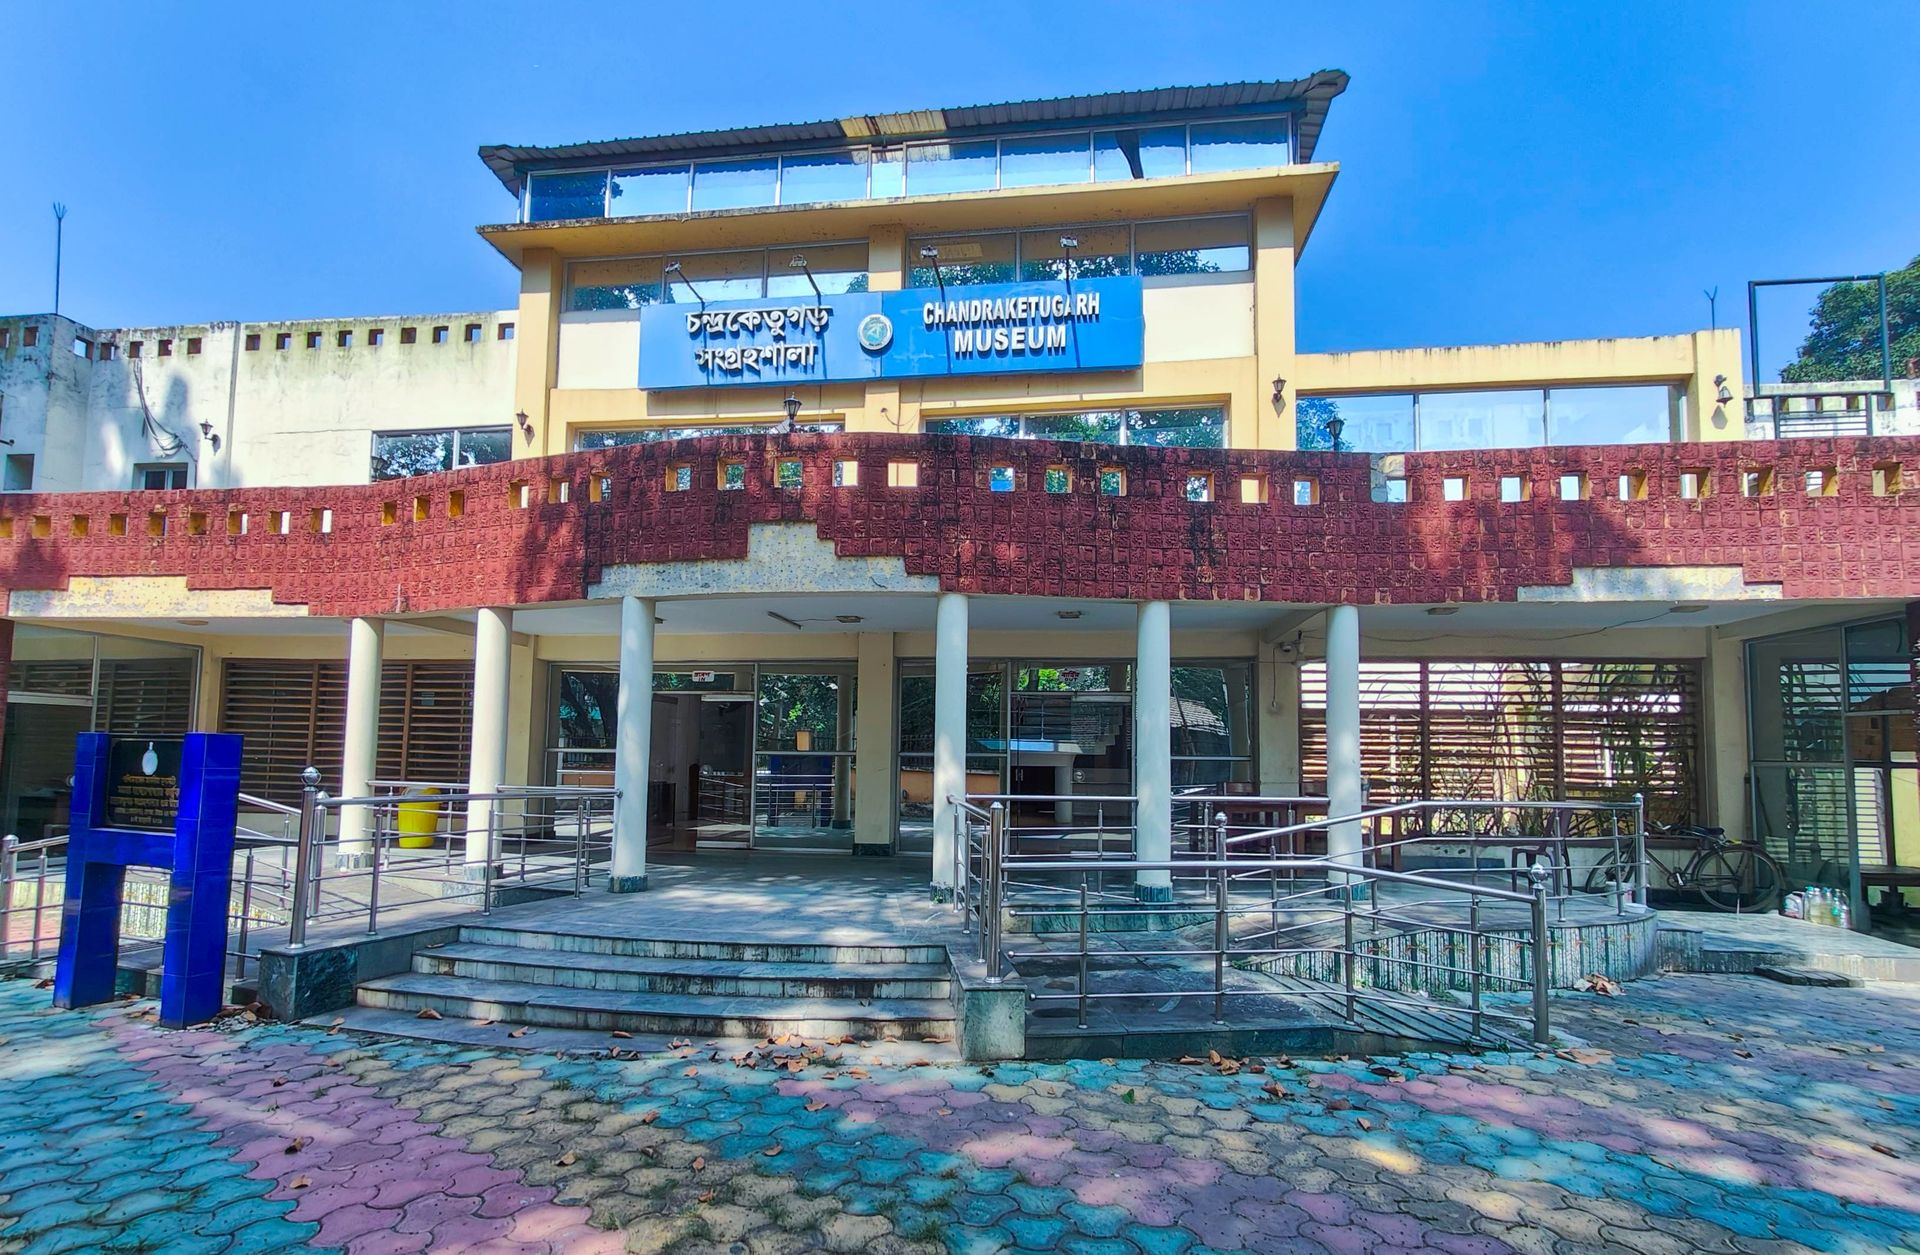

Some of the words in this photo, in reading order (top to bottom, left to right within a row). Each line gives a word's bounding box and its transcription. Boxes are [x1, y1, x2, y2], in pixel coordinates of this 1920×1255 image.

[685, 304, 834, 336] চন্দ্রকেতুগড়
[923, 292, 1100, 325] CHANDRAKETUGARH
[954, 325, 1066, 353] MUSEUM
[696, 340, 817, 370] সংগ্রহশালা
